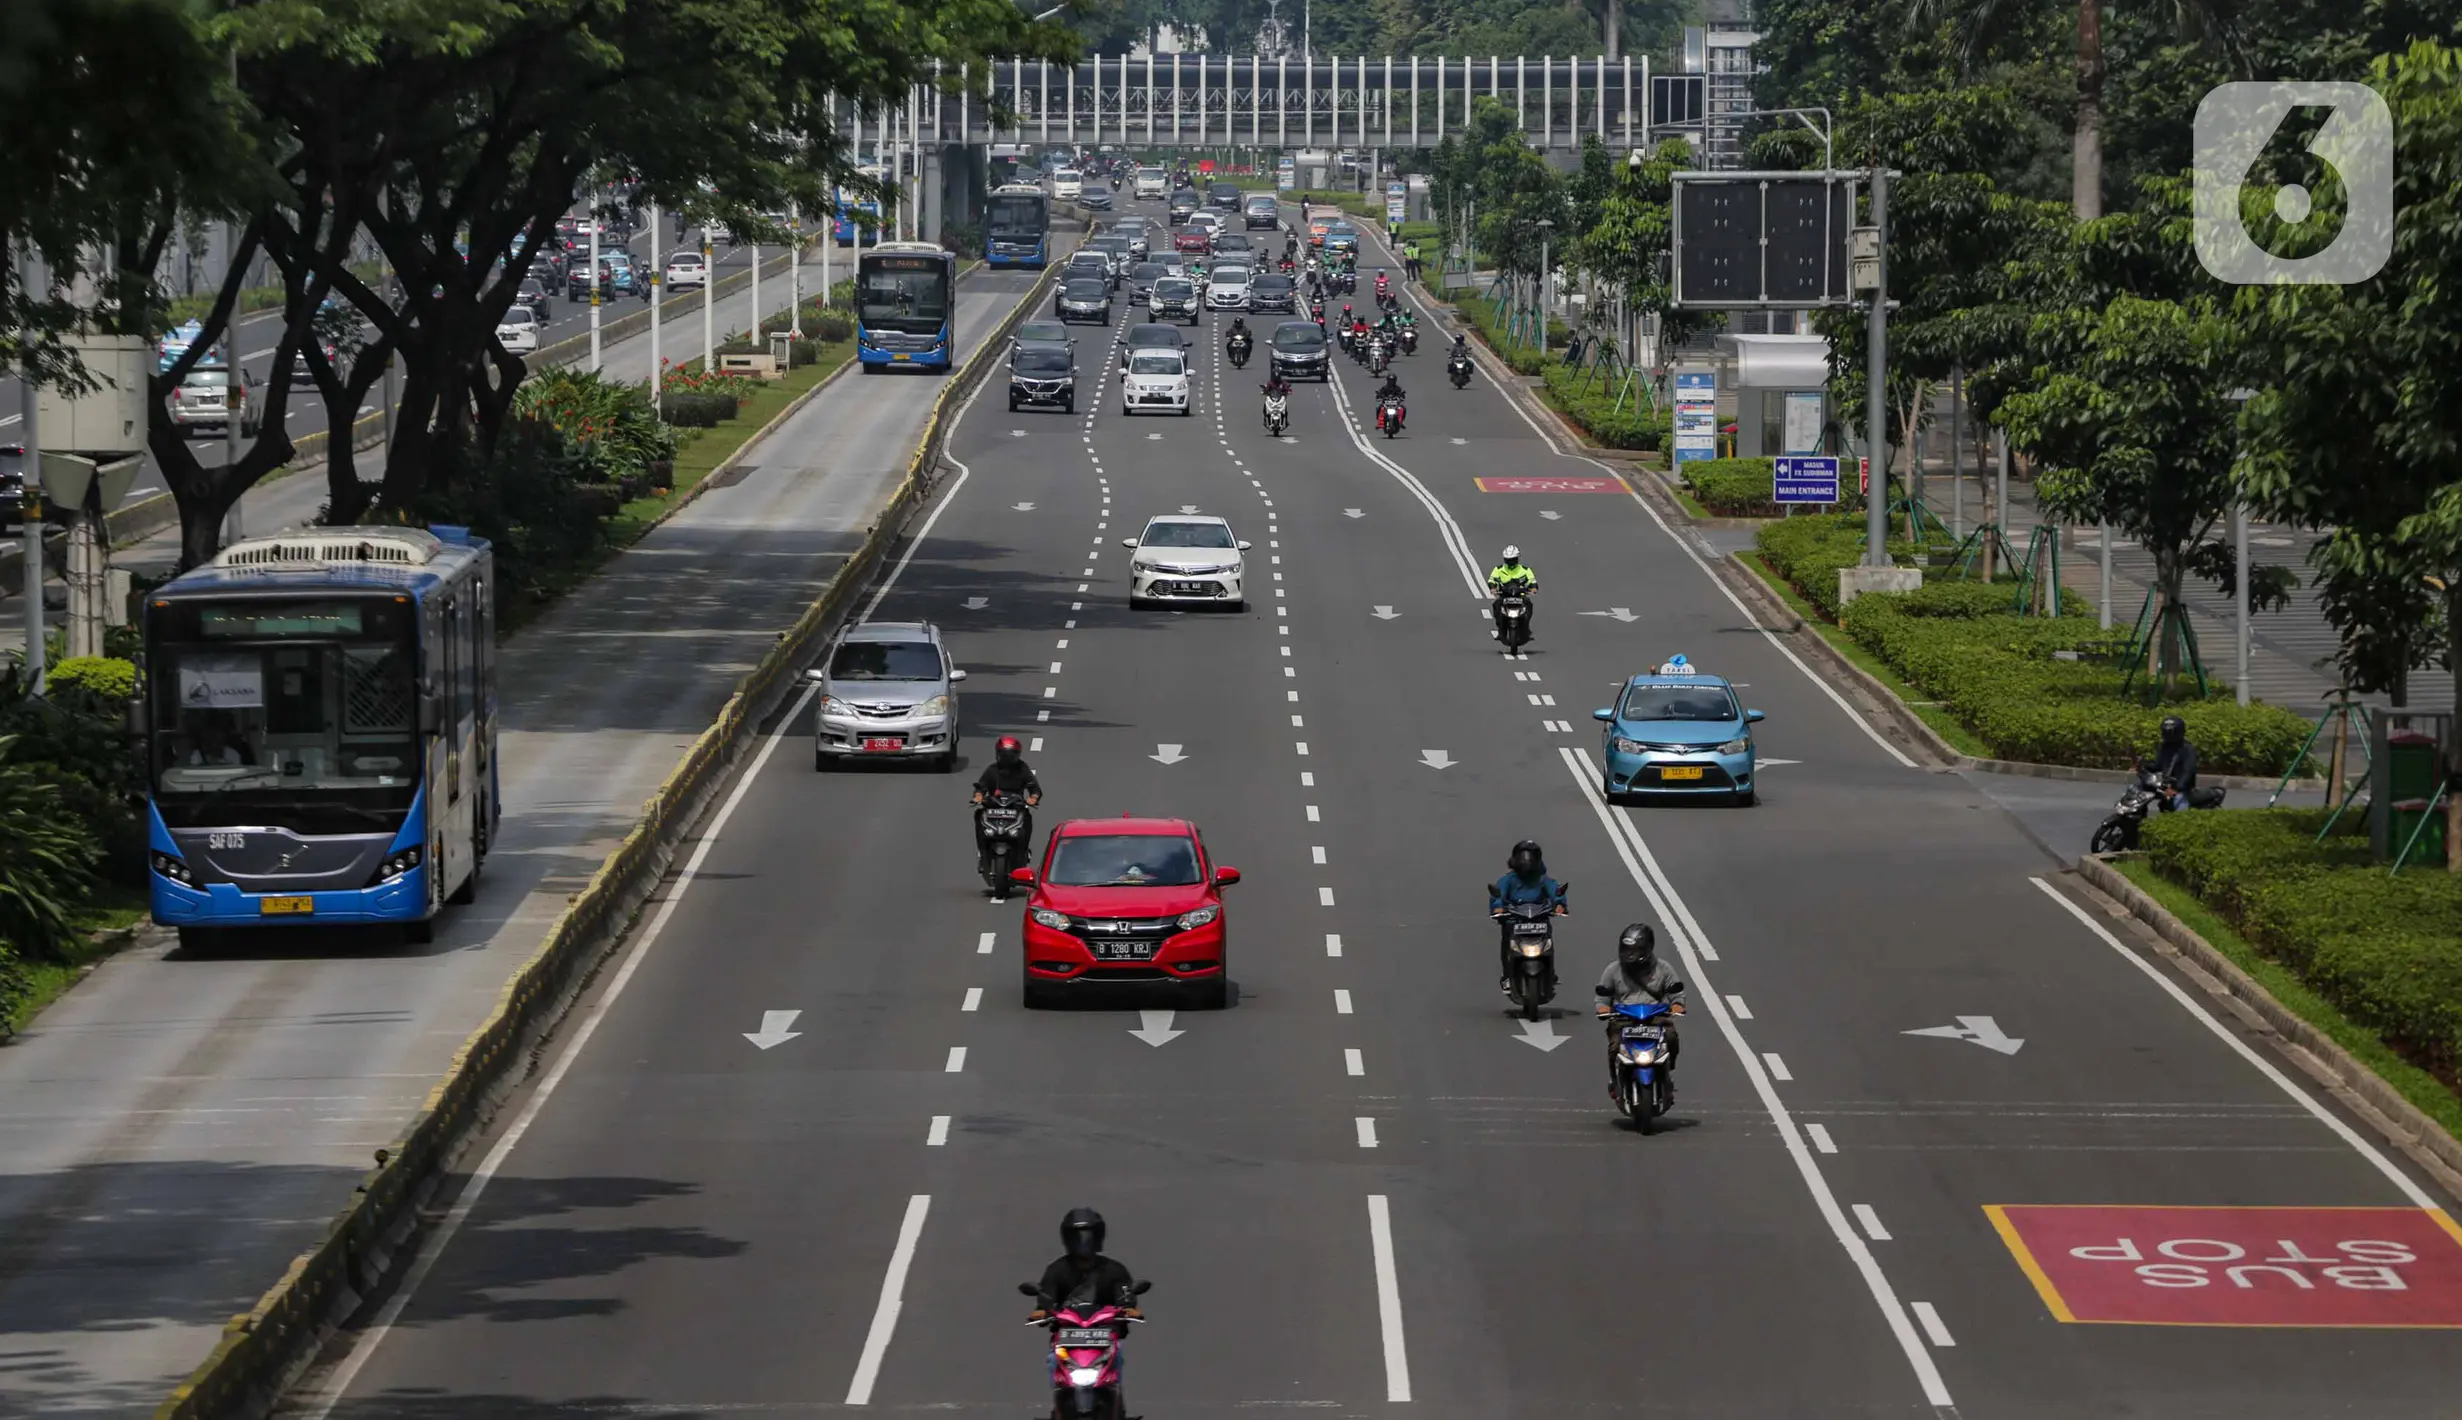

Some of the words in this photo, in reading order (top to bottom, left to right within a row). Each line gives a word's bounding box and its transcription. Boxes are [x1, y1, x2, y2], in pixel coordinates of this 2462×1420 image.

[1798, 487, 1834, 495] ENTRANCE
[209, 833, 226, 849] SAF
[226, 833, 245, 849] 075
[1099, 944, 1105, 954] B
[1111, 944, 1129, 954] 1280
[1133, 944, 1149, 954] KRJ
[2068, 1238, 2418, 1264] STOP
[2134, 1263, 2409, 1290] BUS
